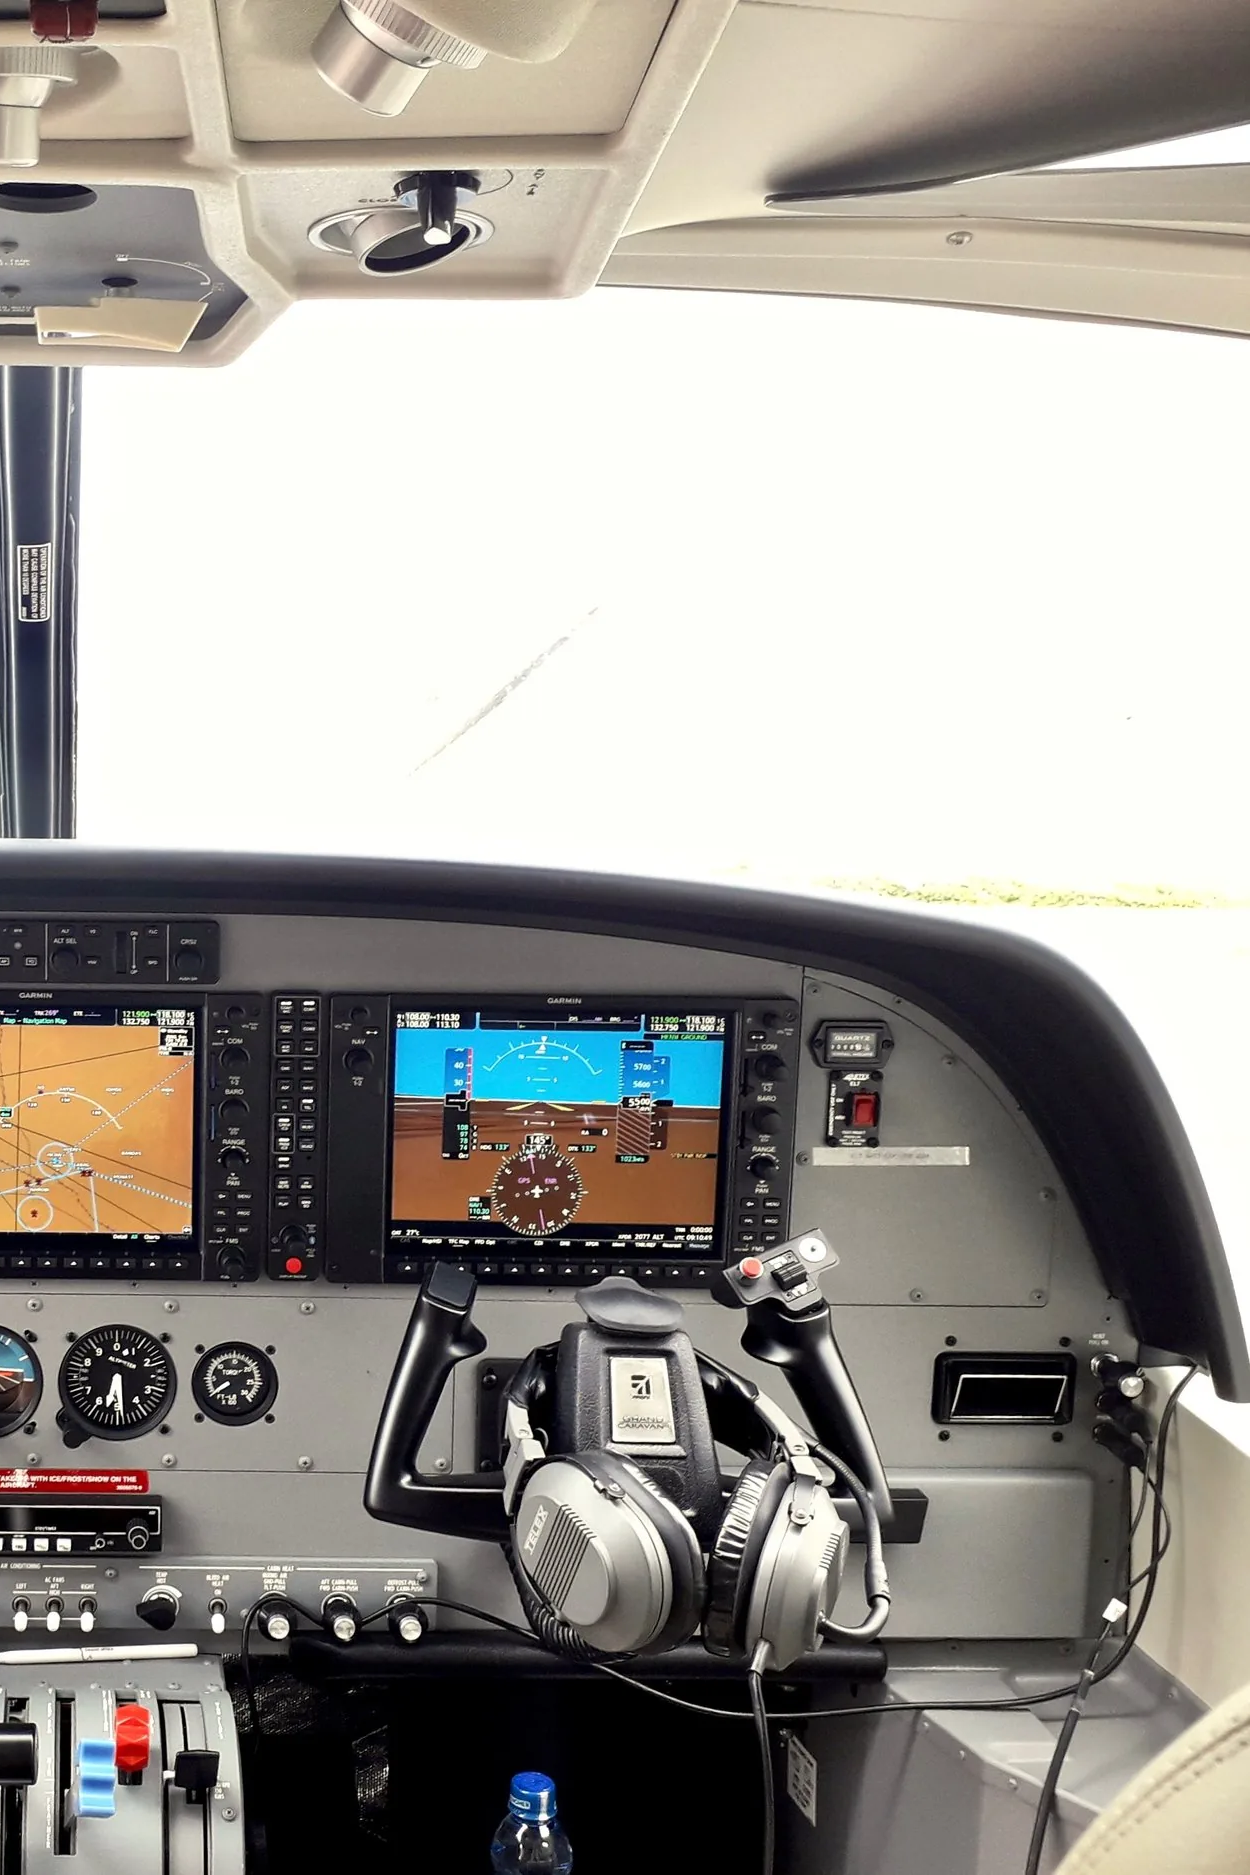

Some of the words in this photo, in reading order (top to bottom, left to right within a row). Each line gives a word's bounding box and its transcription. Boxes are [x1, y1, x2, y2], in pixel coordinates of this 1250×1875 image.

[122, 1010, 150, 1018] 121.900
[156, 1010, 185, 1018] 118.100
[405, 1013, 430, 1021] 108.00
[686, 1016, 715, 1024] 118.100
[602, 1128, 608, 1136] 0
[529, 1136, 550, 1144] 145°
[114, 1343, 121, 1351] 0
[96, 1348, 103, 1357] 9
[84, 1358, 92, 1367] 8
[143, 1358, 151, 1367] 2
[84, 1386, 92, 1395] 7
[144, 1386, 152, 1395] 3
[95, 1397, 103, 1405] 6
[132, 1396, 140, 1404] 4
[622, 1415, 664, 1423] GRAND
[523, 1504, 550, 1556] TELEX
